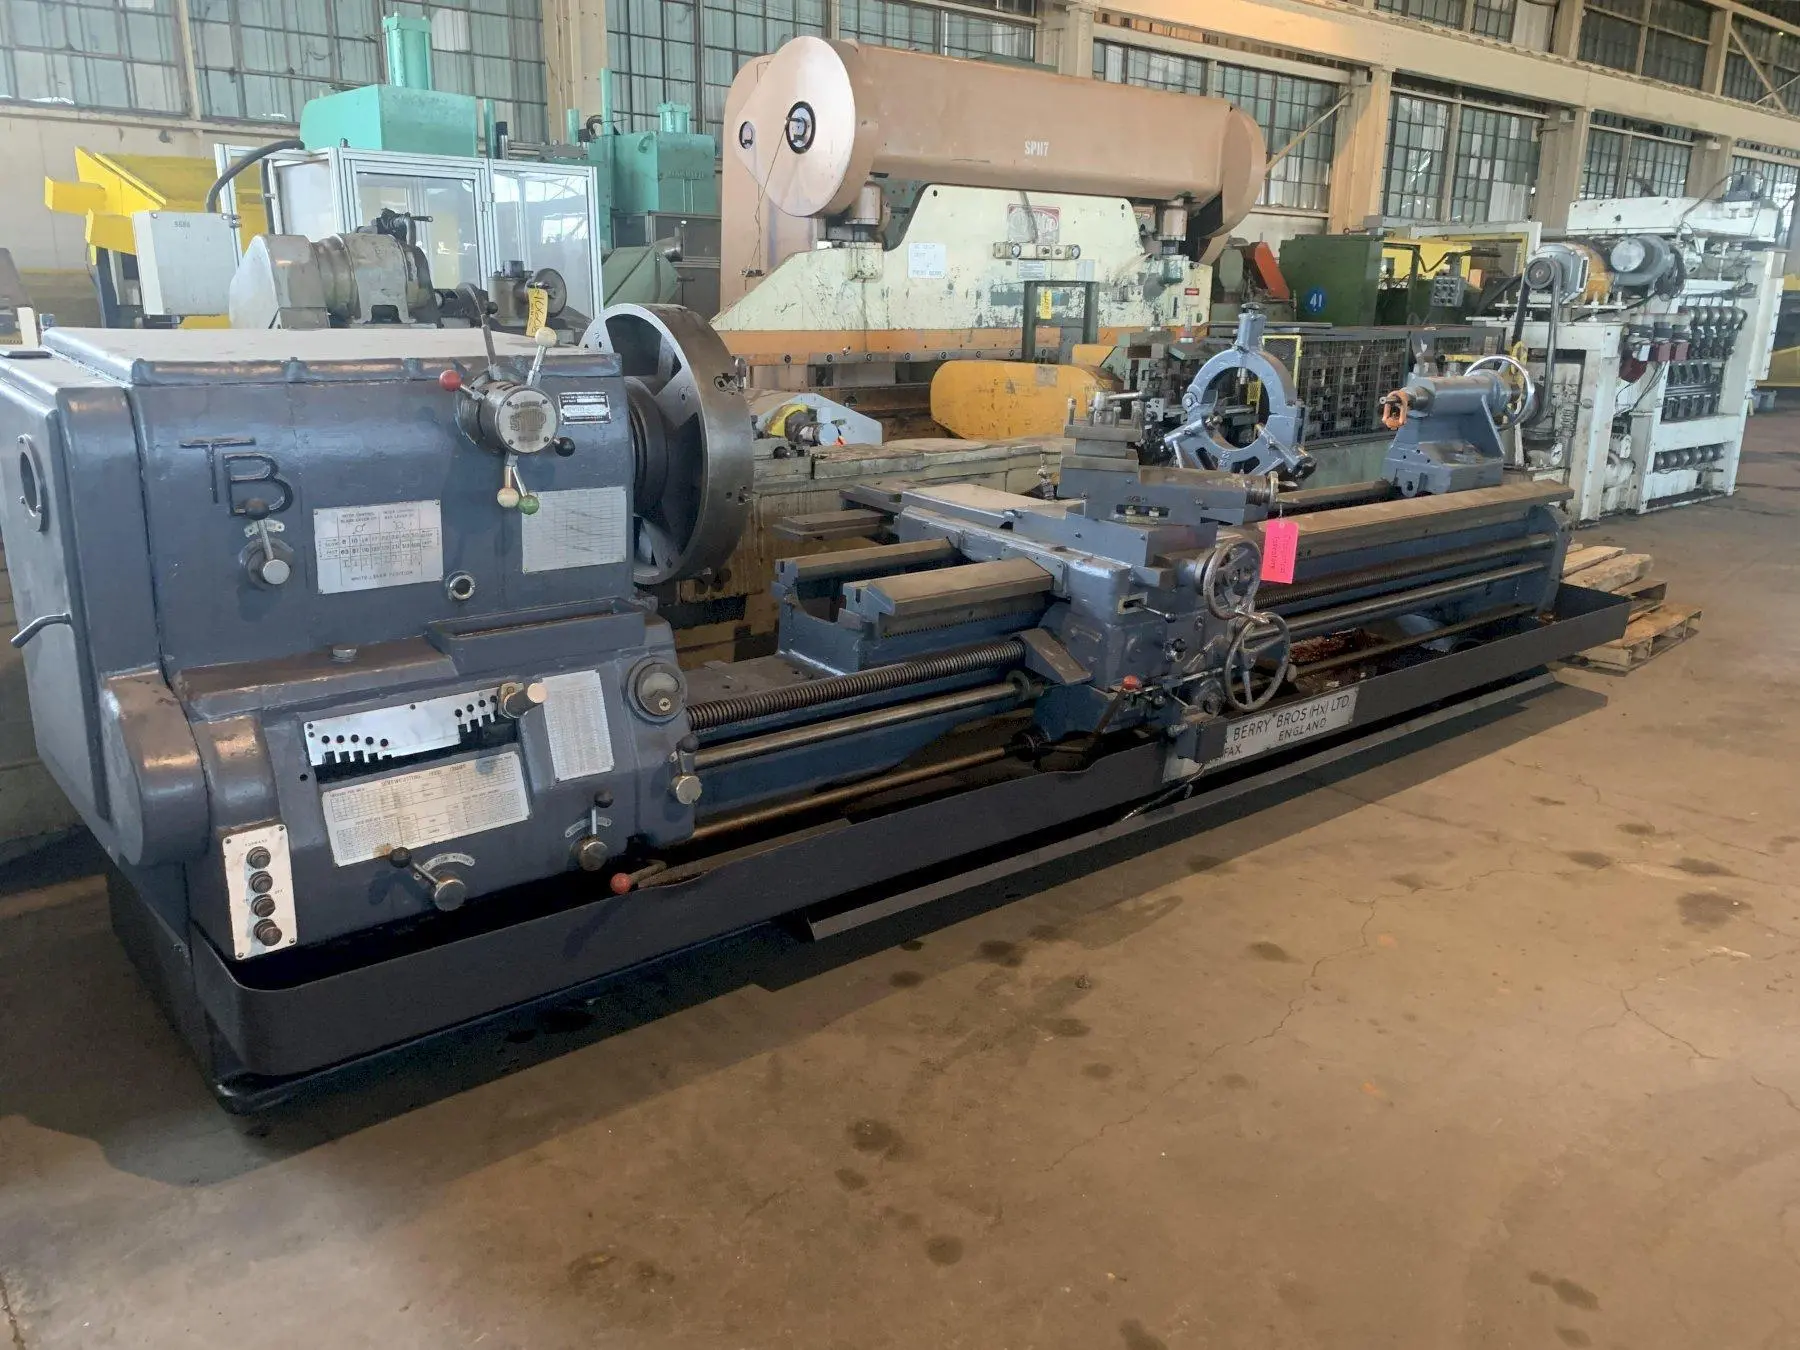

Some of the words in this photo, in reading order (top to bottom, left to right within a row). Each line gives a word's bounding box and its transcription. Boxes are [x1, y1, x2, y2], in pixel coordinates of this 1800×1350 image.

[1309, 293, 1323, 308] 41
[1233, 717, 1271, 741] BERRY
[1277, 707, 1308, 728] BROS
[1278, 717, 1327, 741] ENGLAND
